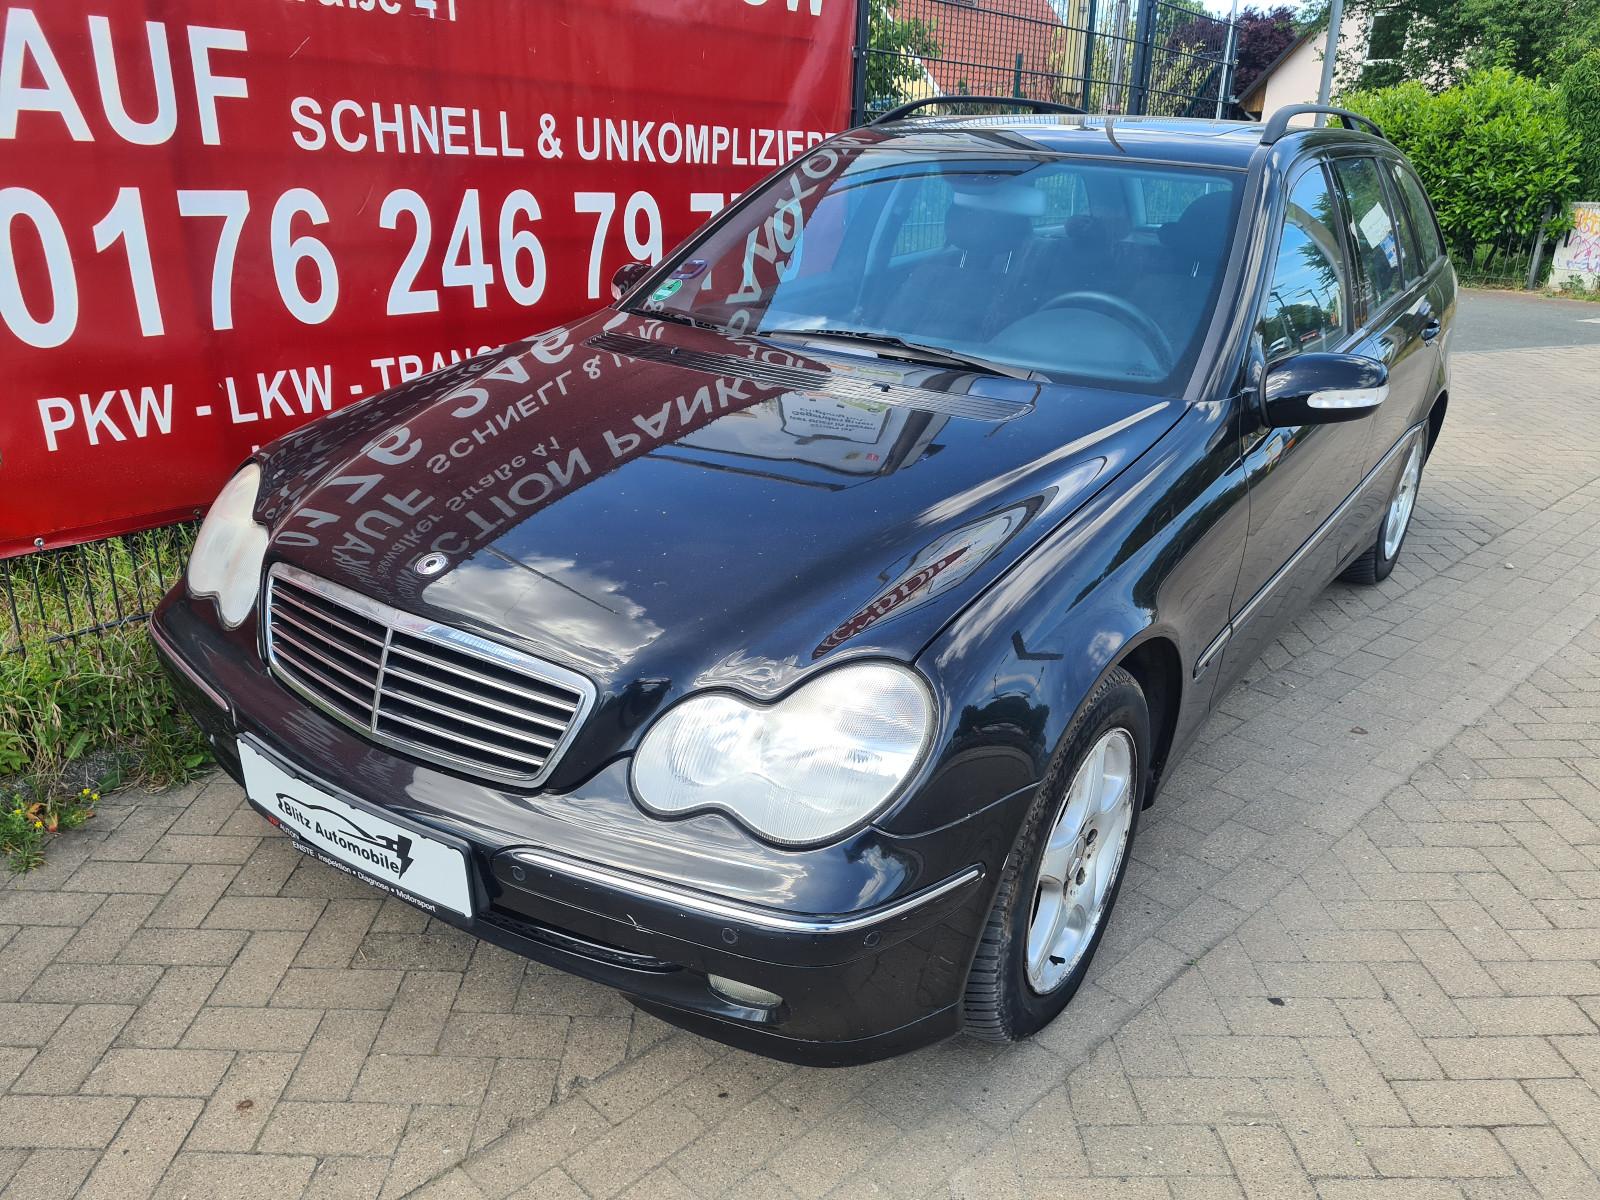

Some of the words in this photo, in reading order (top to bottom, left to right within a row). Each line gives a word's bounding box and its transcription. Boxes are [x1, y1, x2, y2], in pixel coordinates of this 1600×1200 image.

[0, 7, 249, 146] AUF
[290, 96, 525, 157] SCHNELL
[537, 113, 564, 159] &
[0, 187, 340, 349] 0176
[379, 188, 546, 315] 246
[574, 190, 663, 299] 79
[37, 383, 173, 452] PKW
[226, 364, 332, 424] LKW
[283, 801, 311, 830] Blitz
[315, 821, 400, 874] Automobile
[357, 871, 390, 892] Diagnose
[396, 888, 436, 913] Motorsport
